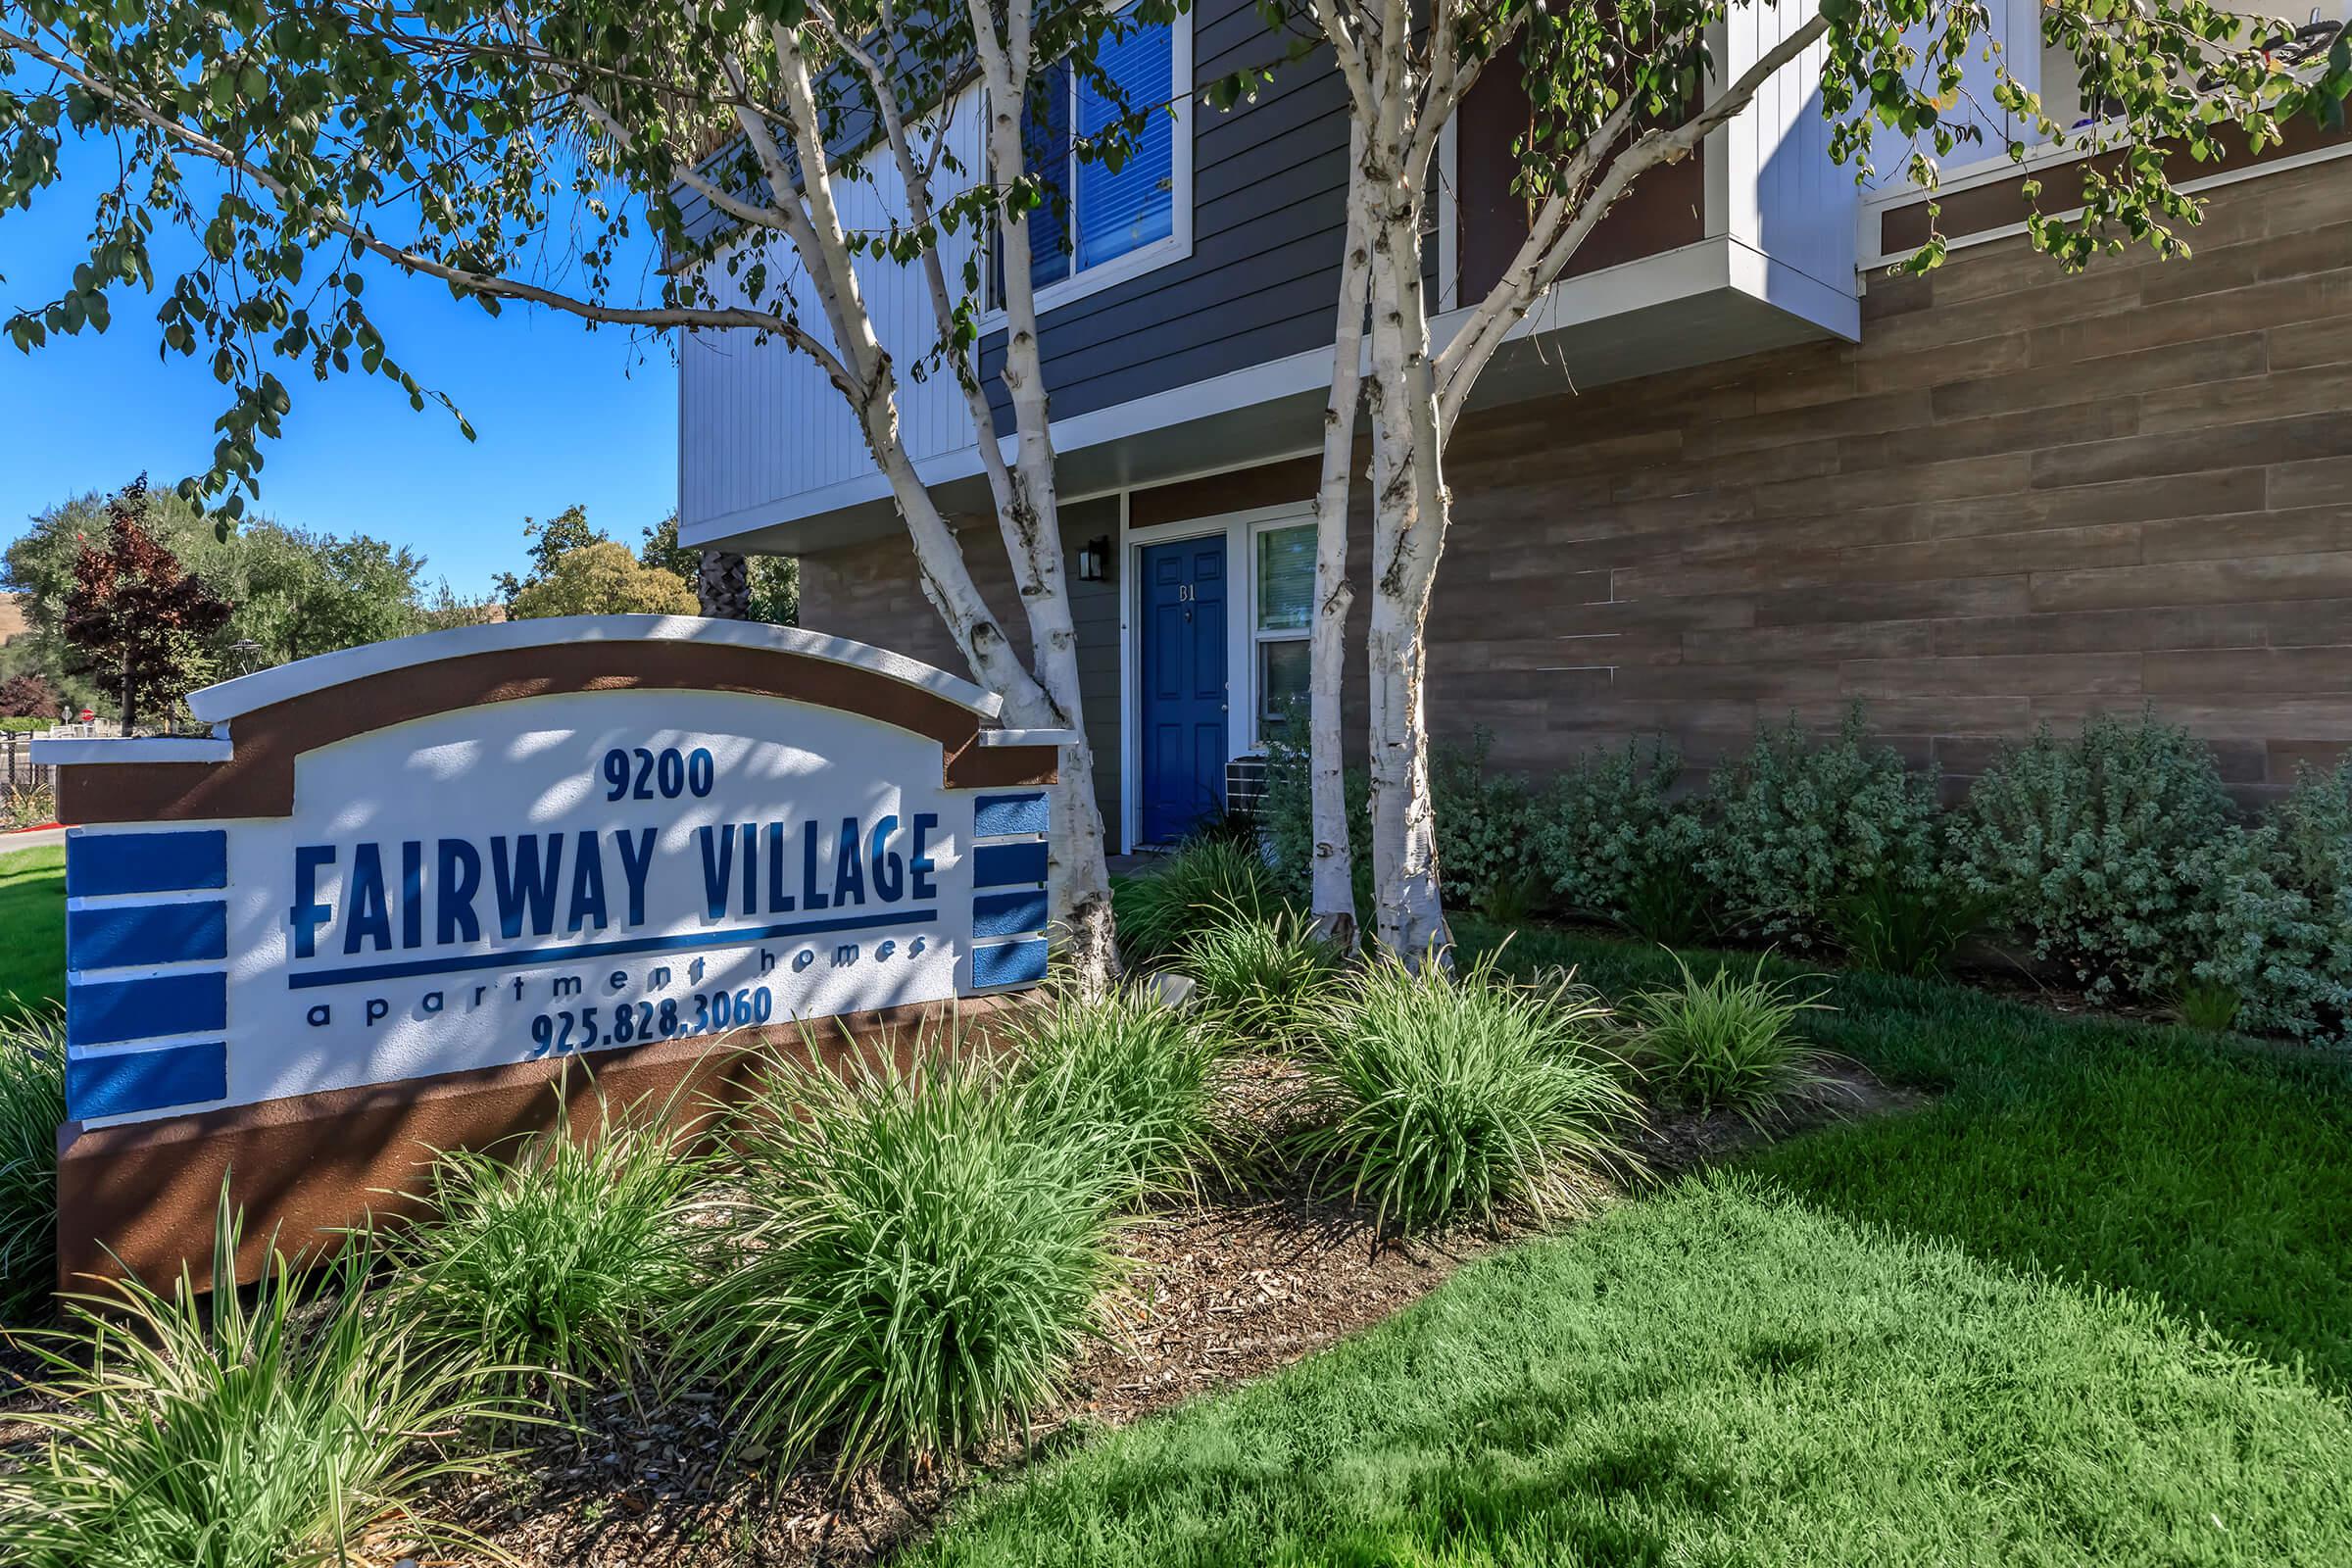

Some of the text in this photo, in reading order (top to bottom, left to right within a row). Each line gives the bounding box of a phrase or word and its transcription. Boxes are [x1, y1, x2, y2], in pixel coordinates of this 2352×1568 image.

[1179, 583, 1196, 602] B1
[604, 747, 714, 802] 9200
[290, 814, 938, 958] FAIRWAY VILLAGE
[307, 933, 927, 1027] apartment homes
[531, 986, 772, 1054] 925.828.3060
